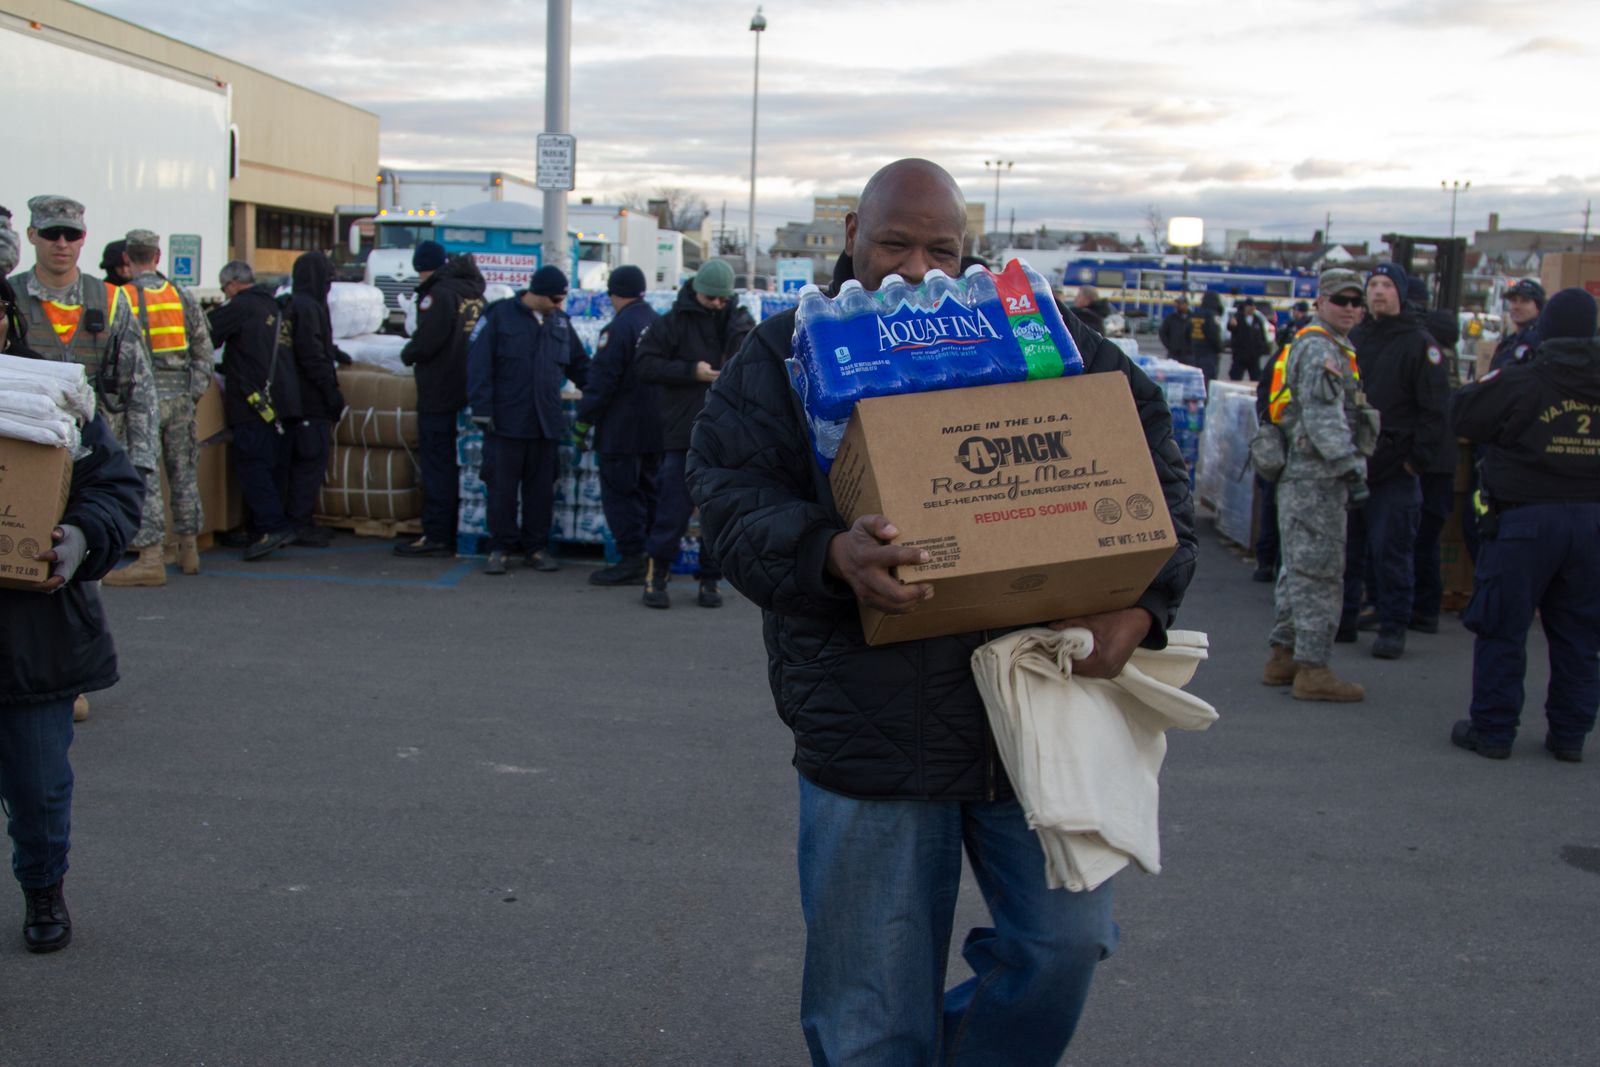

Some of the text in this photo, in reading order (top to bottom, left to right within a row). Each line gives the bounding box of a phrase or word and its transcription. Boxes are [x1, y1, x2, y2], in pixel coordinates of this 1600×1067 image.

[504, 255, 535, 266] FLUSH
[1006, 294, 1031, 311] 24
[876, 307, 1003, 352] AQUAFINA
[942, 413, 1073, 435] MADE IN THE U.S.A.
[1577, 414, 1591, 434] 2
[1545, 445, 1565, 454] AND
[1566, 446, 1596, 455] RESCUE
[1553, 436, 1581, 446] URBAN
[930, 459, 1109, 500] Ready Meal
[923, 476, 1127, 509] SELF-HEATING EMERGENCY MEAL
[973, 505, 1036, 524] REDUCED
[1039, 500, 1088, 517] SODIUM
[1, 520, 26, 529] MEAL
[1098, 535, 1116, 548] NET
[1136, 531, 1148, 543] 12
[1149, 529, 1167, 541] LBS
[951, 546, 961, 554] LLC
[16, 566, 24, 574] 12
[25, 567, 39, 576] LBS
